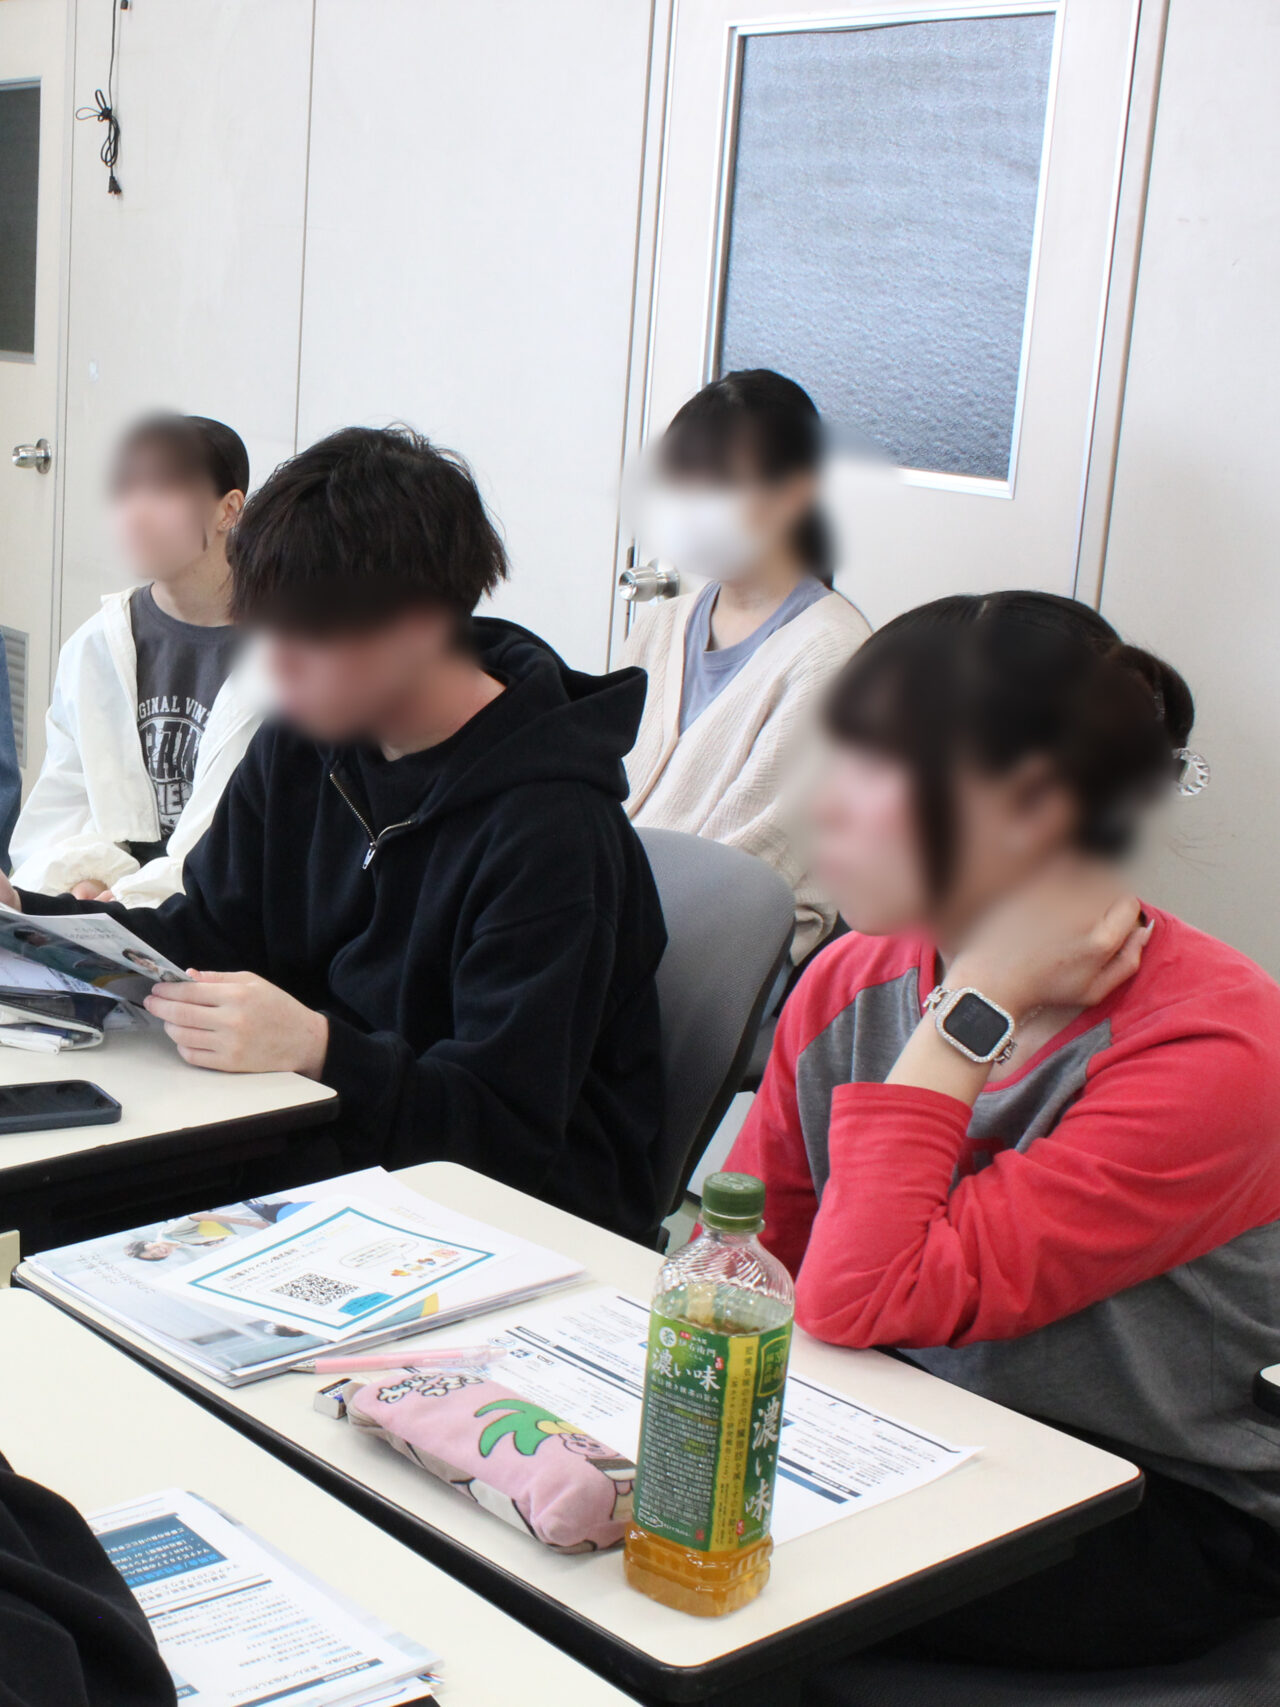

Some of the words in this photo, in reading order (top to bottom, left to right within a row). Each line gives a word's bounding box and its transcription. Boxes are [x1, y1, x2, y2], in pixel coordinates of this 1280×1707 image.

[137, 696, 180, 722] GINAL
[652, 1347, 720, 1391] 濃い味
[745, 1395, 779, 1521] 濃い味
